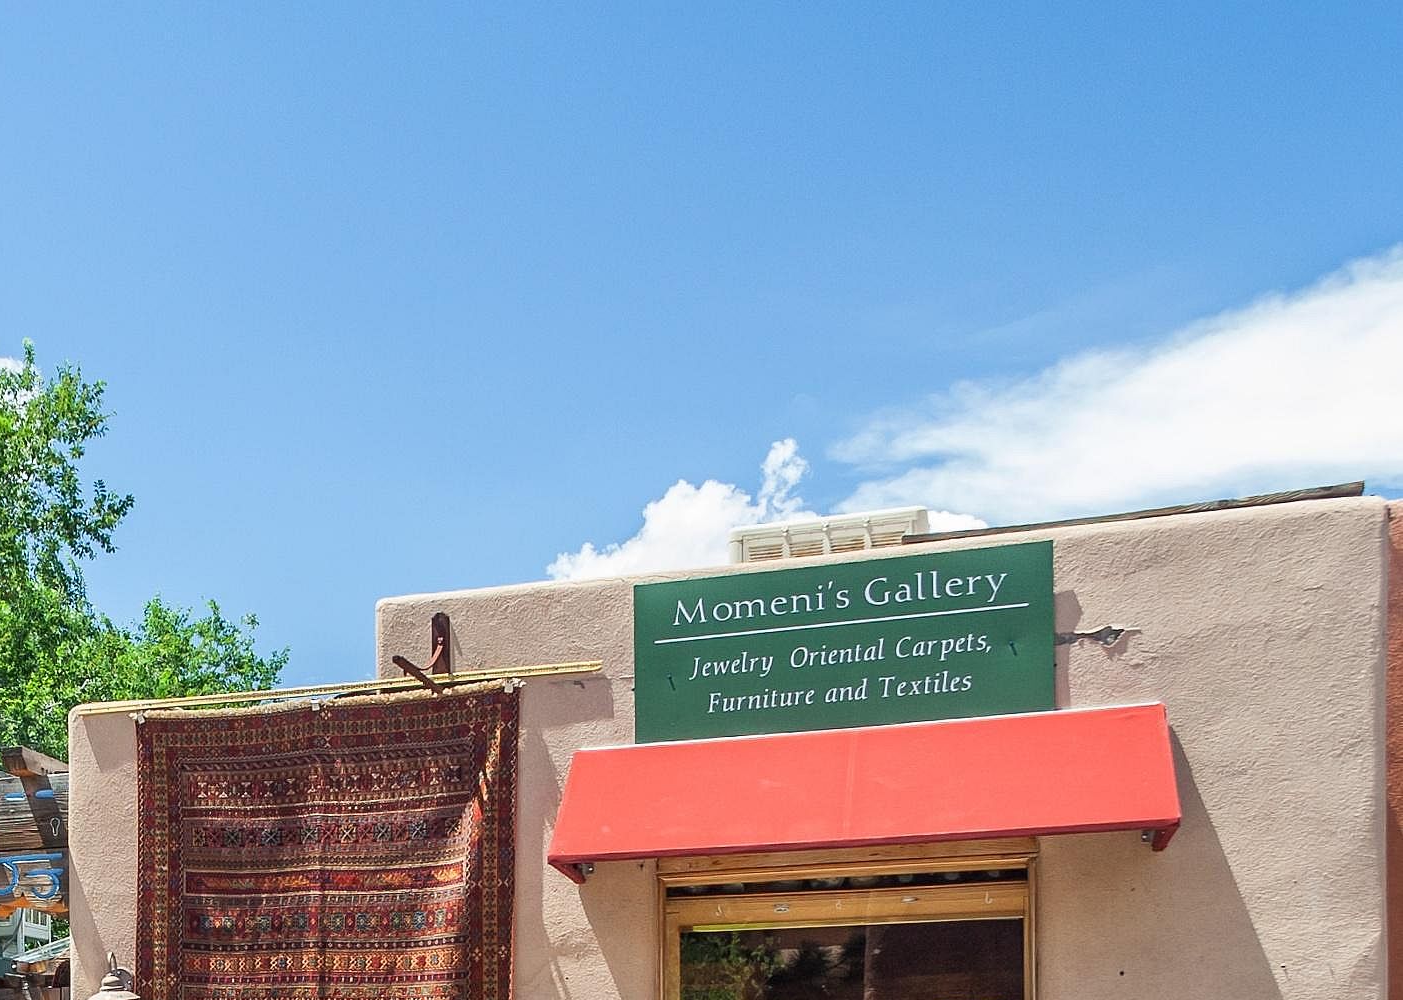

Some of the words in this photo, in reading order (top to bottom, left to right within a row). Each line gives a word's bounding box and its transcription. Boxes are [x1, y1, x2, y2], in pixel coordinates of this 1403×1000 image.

[673, 582, 850, 626] Momeni's
[864, 571, 1008, 607] Gallery
[689, 652, 774, 681] Jewelry
[791, 638, 885, 668] Oriental
[896, 633, 992, 662] Carpets,
[708, 689, 815, 713] Furniture
[825, 678, 868, 703] and
[879, 671, 973, 698] Textiles
